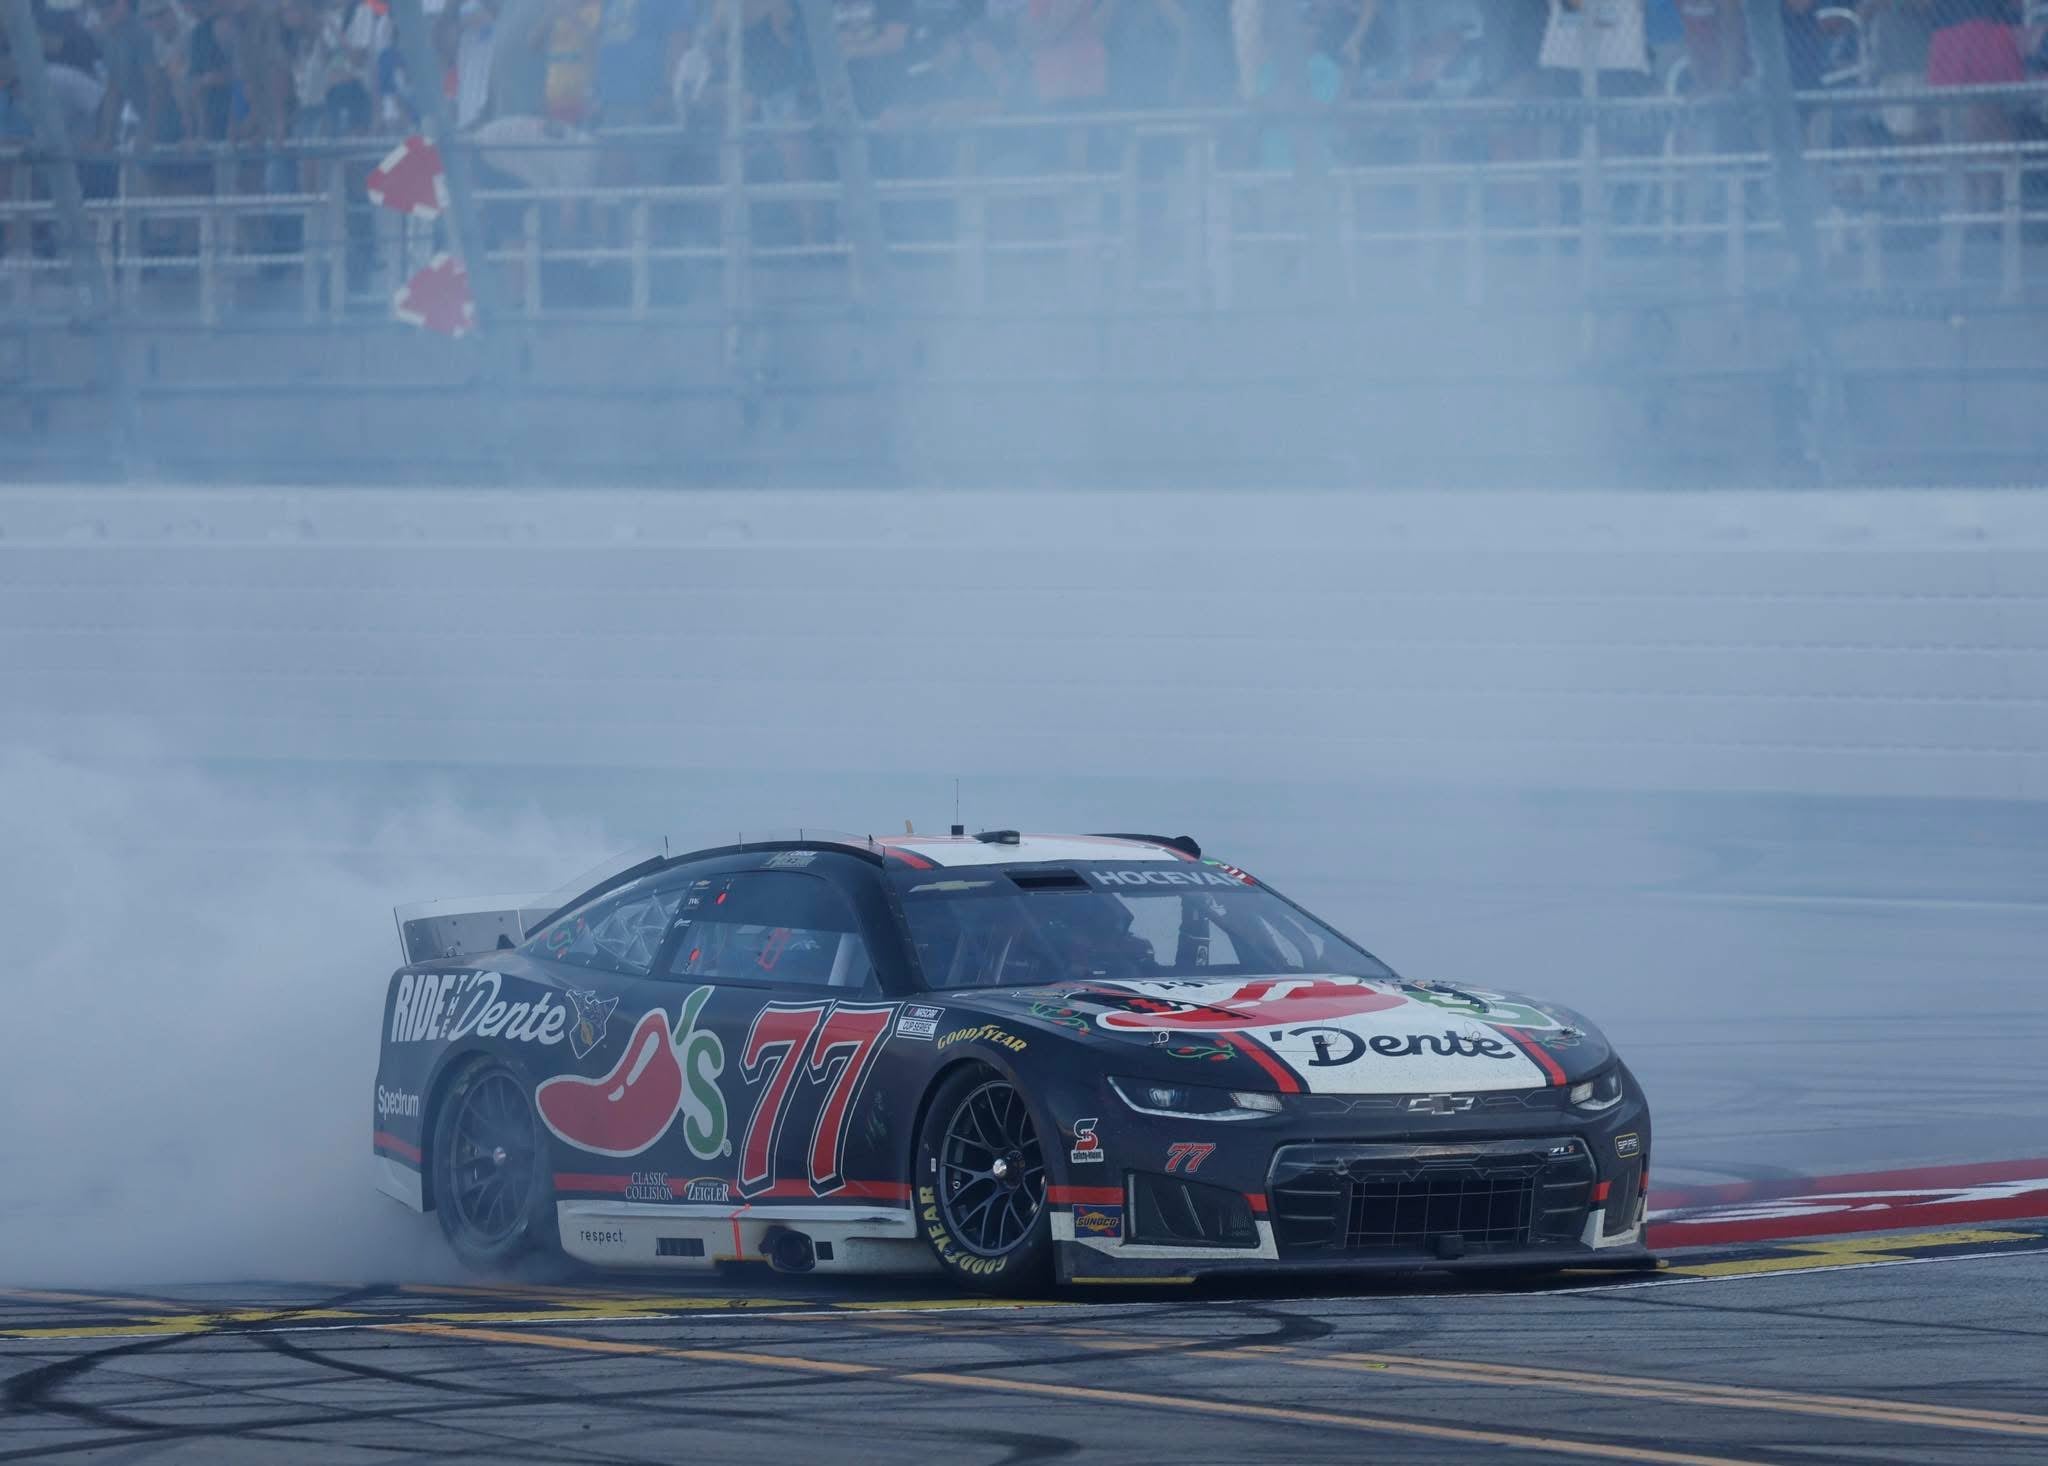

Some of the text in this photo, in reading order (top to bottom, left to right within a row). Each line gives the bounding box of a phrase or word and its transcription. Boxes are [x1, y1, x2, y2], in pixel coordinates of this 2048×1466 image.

[391, 974, 456, 1042] RIDE
[937, 1024, 1028, 1052] GOODYEAR
[378, 1084, 419, 1121] Spectrum
[738, 998, 905, 1199] 77
[1164, 1142, 1217, 1173] 77
[625, 1185, 673, 1200] COLLISION
[631, 1171, 668, 1186] CLASSIC
[687, 1182, 729, 1202] ZEIGLER
[919, 1186, 1008, 1275] GOODYEAR
[1075, 1215, 1120, 1228] SUNOCO
